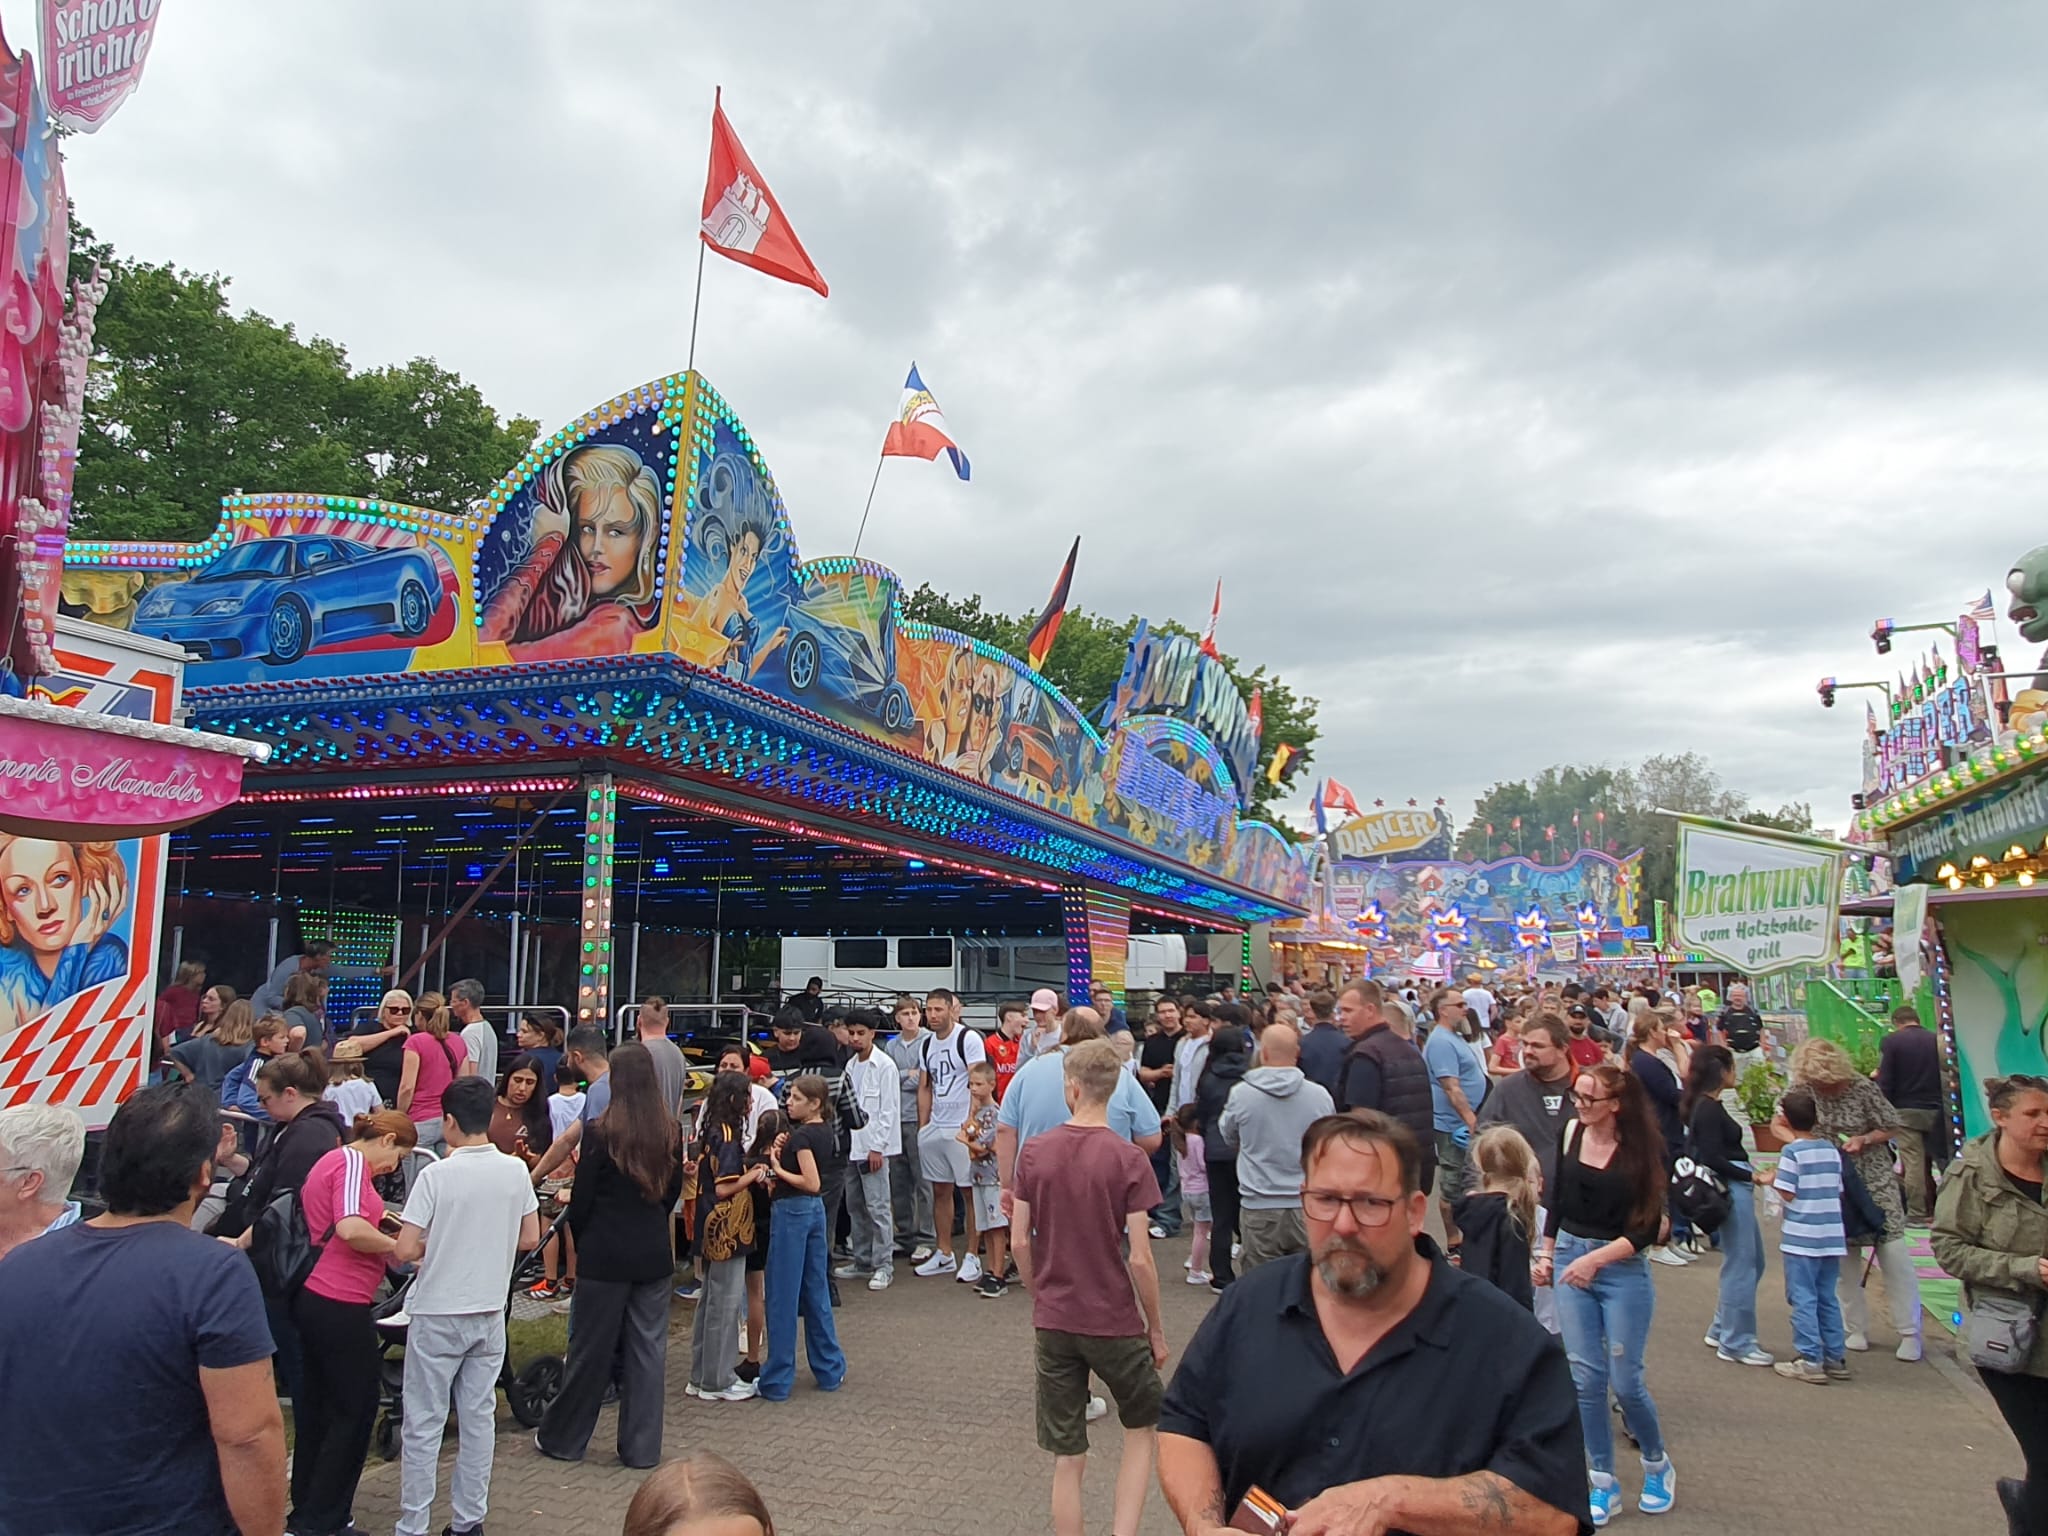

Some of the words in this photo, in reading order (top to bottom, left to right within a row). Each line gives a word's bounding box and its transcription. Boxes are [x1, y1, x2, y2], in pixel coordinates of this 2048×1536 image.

[56, 27, 149, 92] früchte
[70, 757, 204, 803] Mandeln
[1334, 811, 1432, 855] DANCER
[1683, 858, 1834, 919] Bratwurst
[1700, 927, 1730, 942] vom
[1736, 914, 1820, 940] Holzkohle-
[1747, 941, 1781, 964] grill
